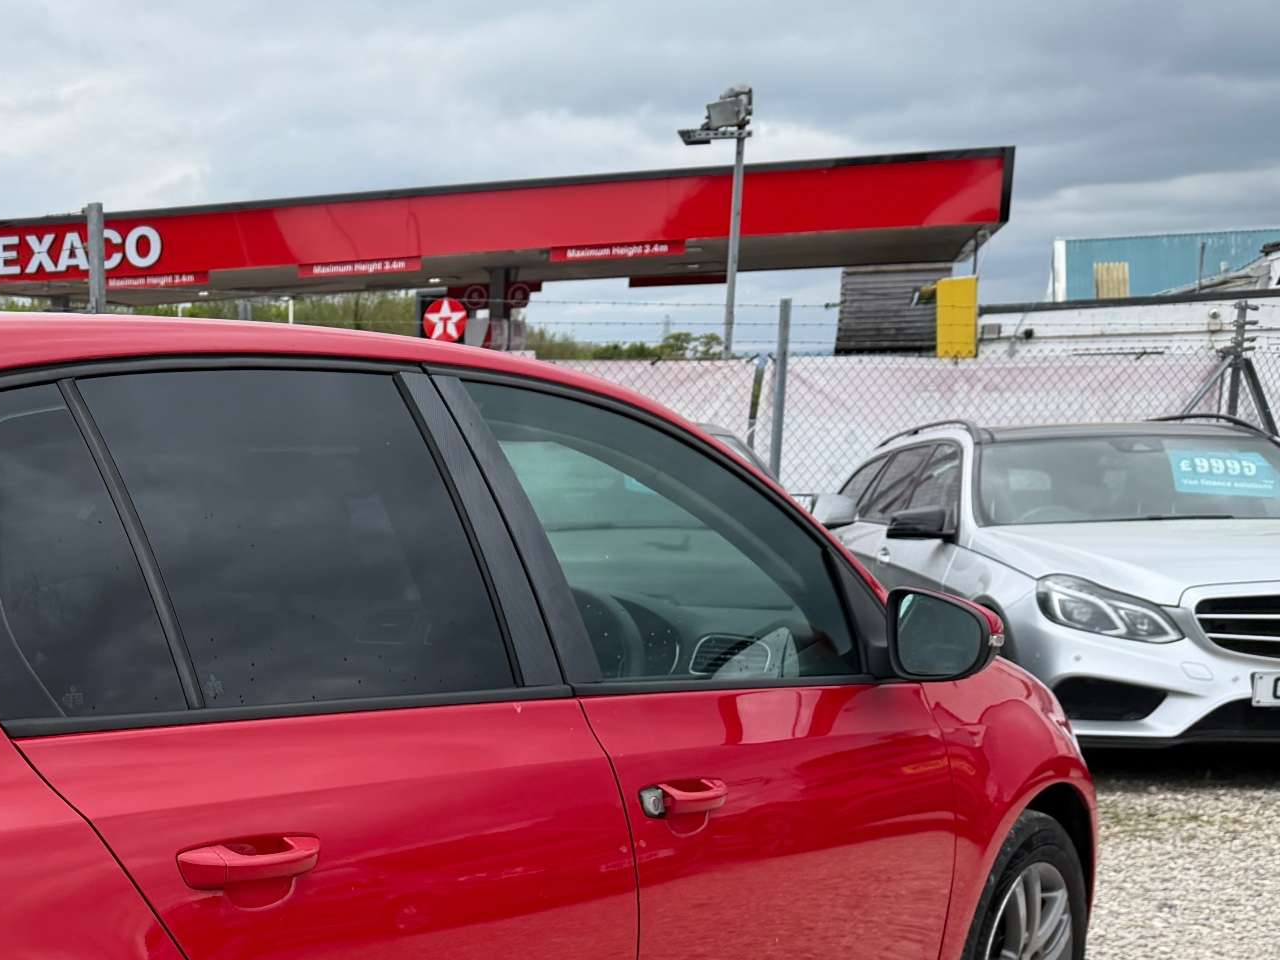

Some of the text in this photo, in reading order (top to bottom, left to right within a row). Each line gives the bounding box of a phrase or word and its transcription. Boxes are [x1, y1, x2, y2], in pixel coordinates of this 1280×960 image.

[566, 247, 610, 258] Maximum
[611, 245, 642, 257] Height
[312, 264, 353, 274] Maximum
[354, 261, 382, 273] Height
[108, 277, 146, 287] Maximum
[146, 274, 173, 286] Height
